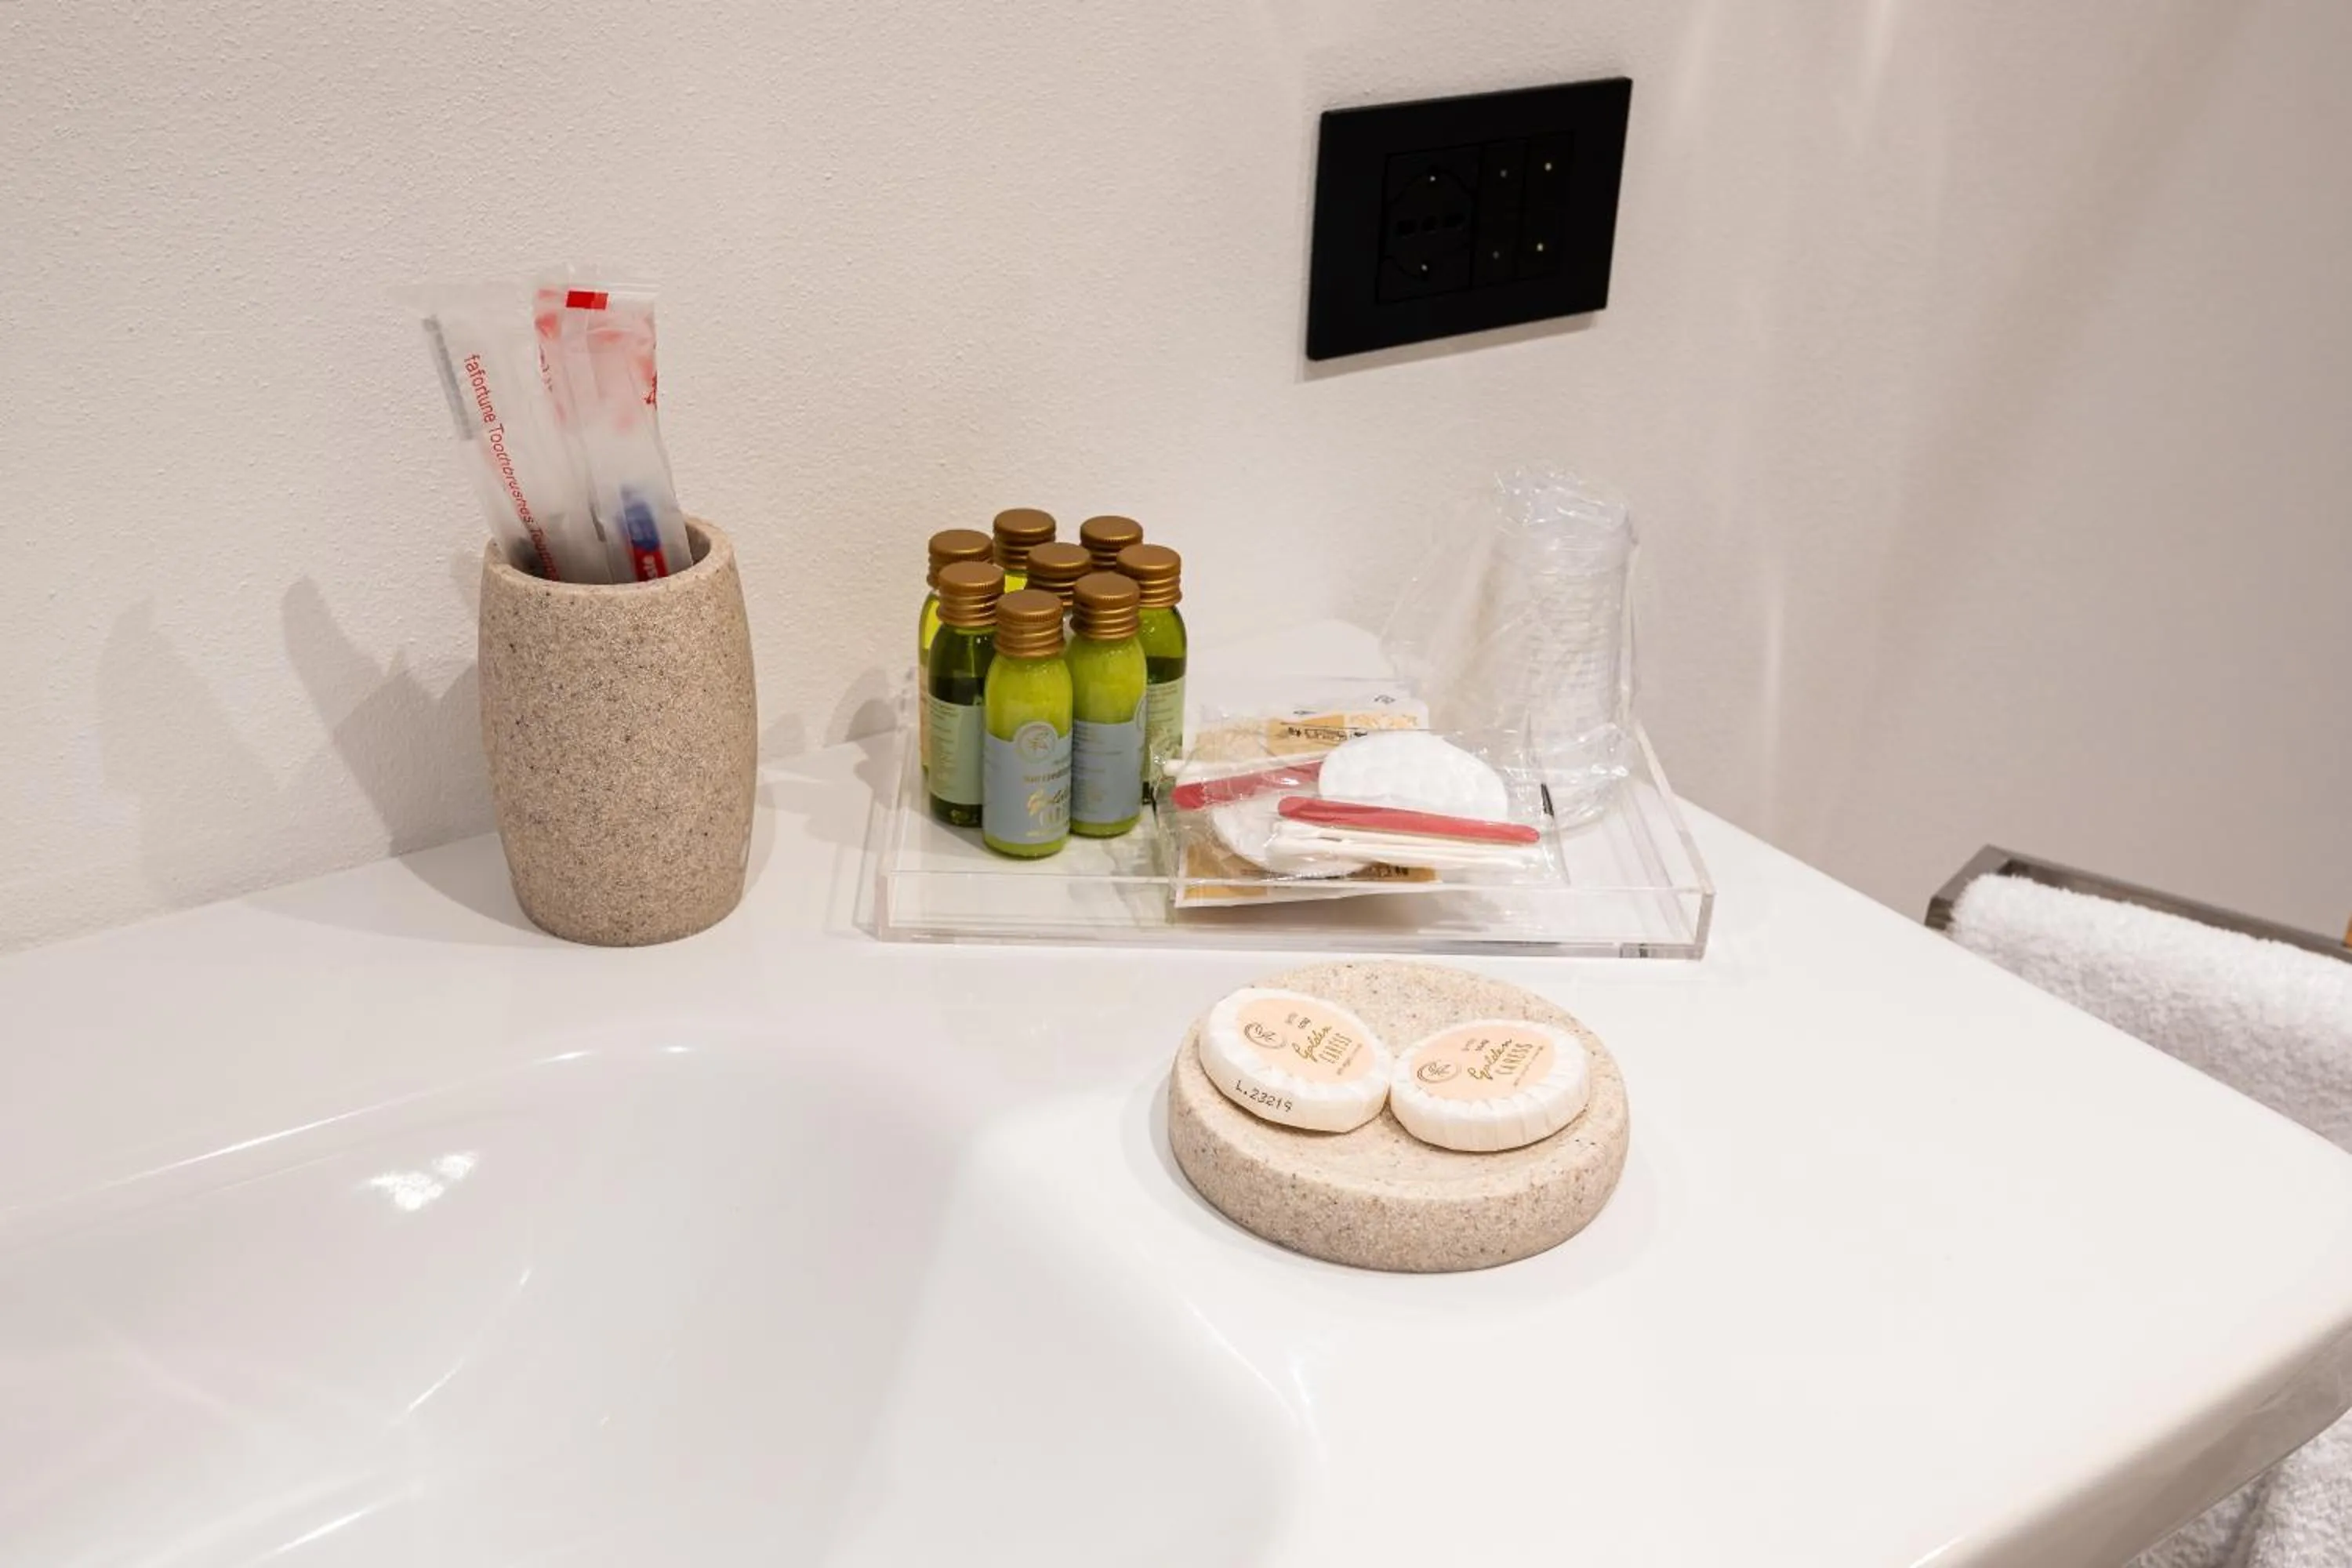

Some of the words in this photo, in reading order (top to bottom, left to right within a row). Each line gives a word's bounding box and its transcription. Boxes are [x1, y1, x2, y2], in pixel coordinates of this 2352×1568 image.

[463, 354, 496, 423] fafortune
[488, 423, 535, 524] Toothbrushes
[1291, 1025, 1333, 1064] Golden
[1467, 1038, 1513, 1081] Golden
